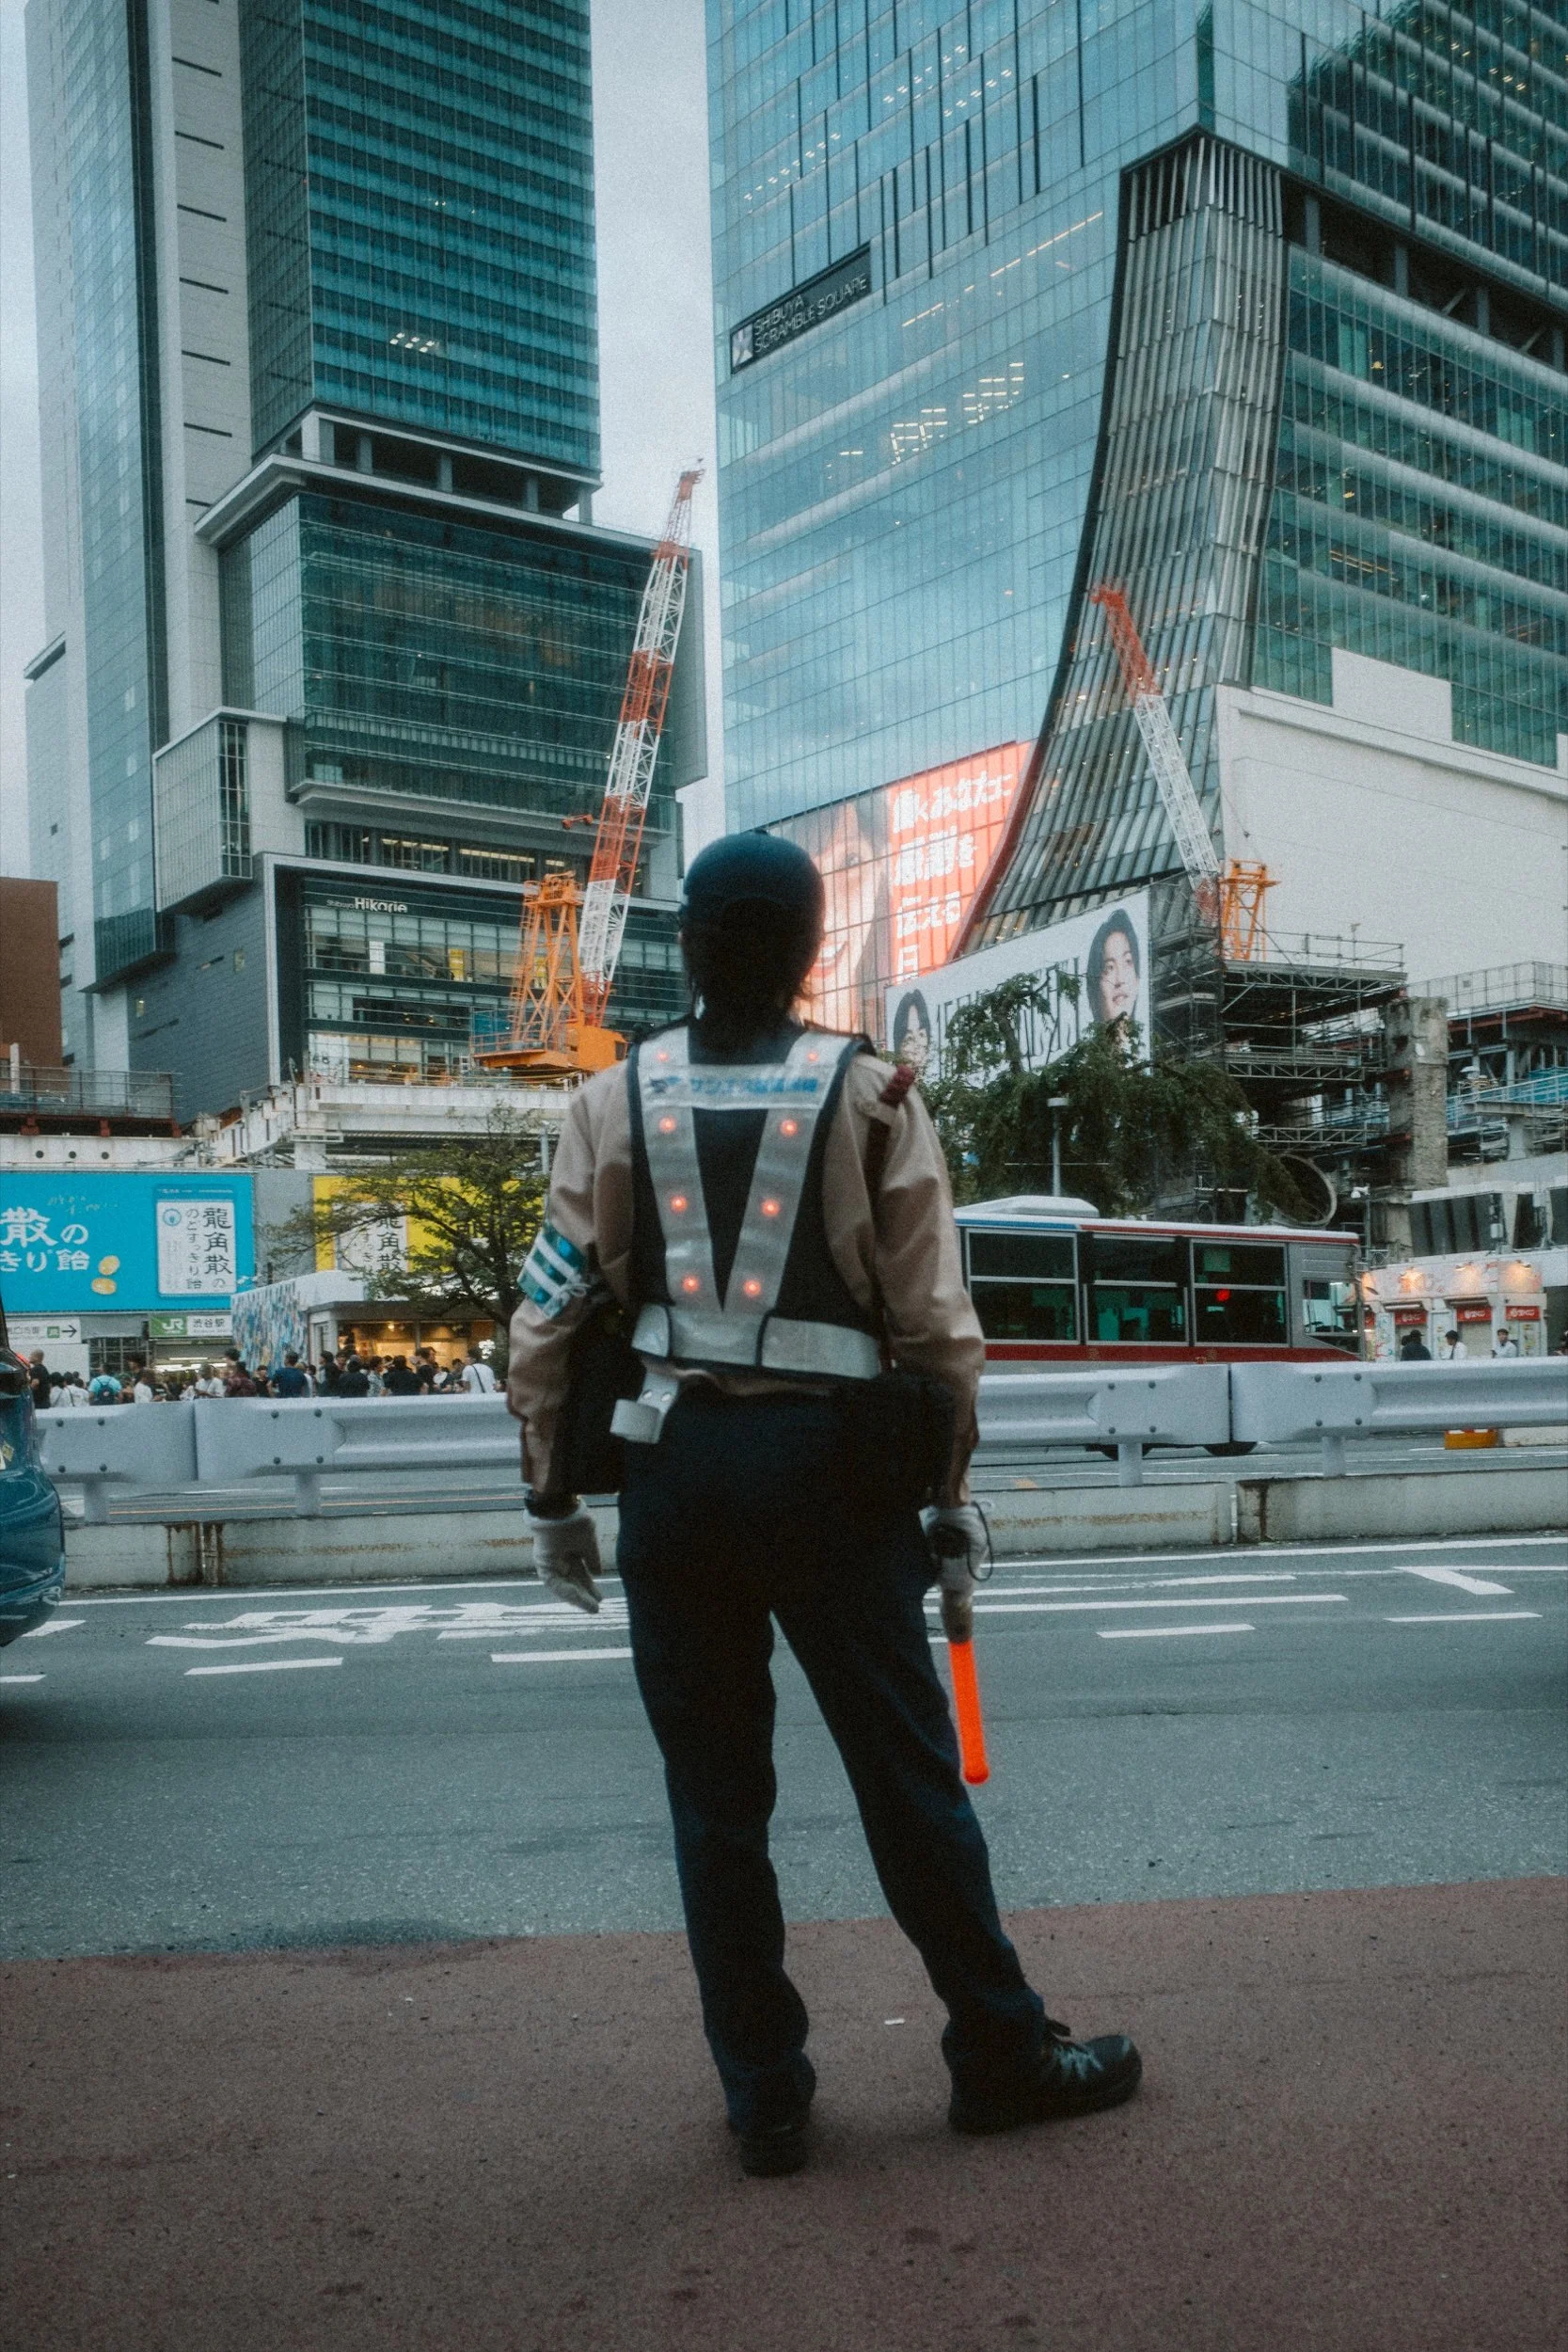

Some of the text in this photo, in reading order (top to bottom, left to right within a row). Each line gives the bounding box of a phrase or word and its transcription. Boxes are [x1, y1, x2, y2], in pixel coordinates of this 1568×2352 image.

[753, 294, 804, 335] SHIBUYA
[754, 272, 867, 353] SCRAMBLE SQUARE
[355, 897, 408, 914] Hikarie
[896, 891, 961, 939] 伝える
[0, 1206, 89, 1248] 散の
[203, 1207, 232, 1289] 龍角散の
[161, 1318, 184, 1330] JR
